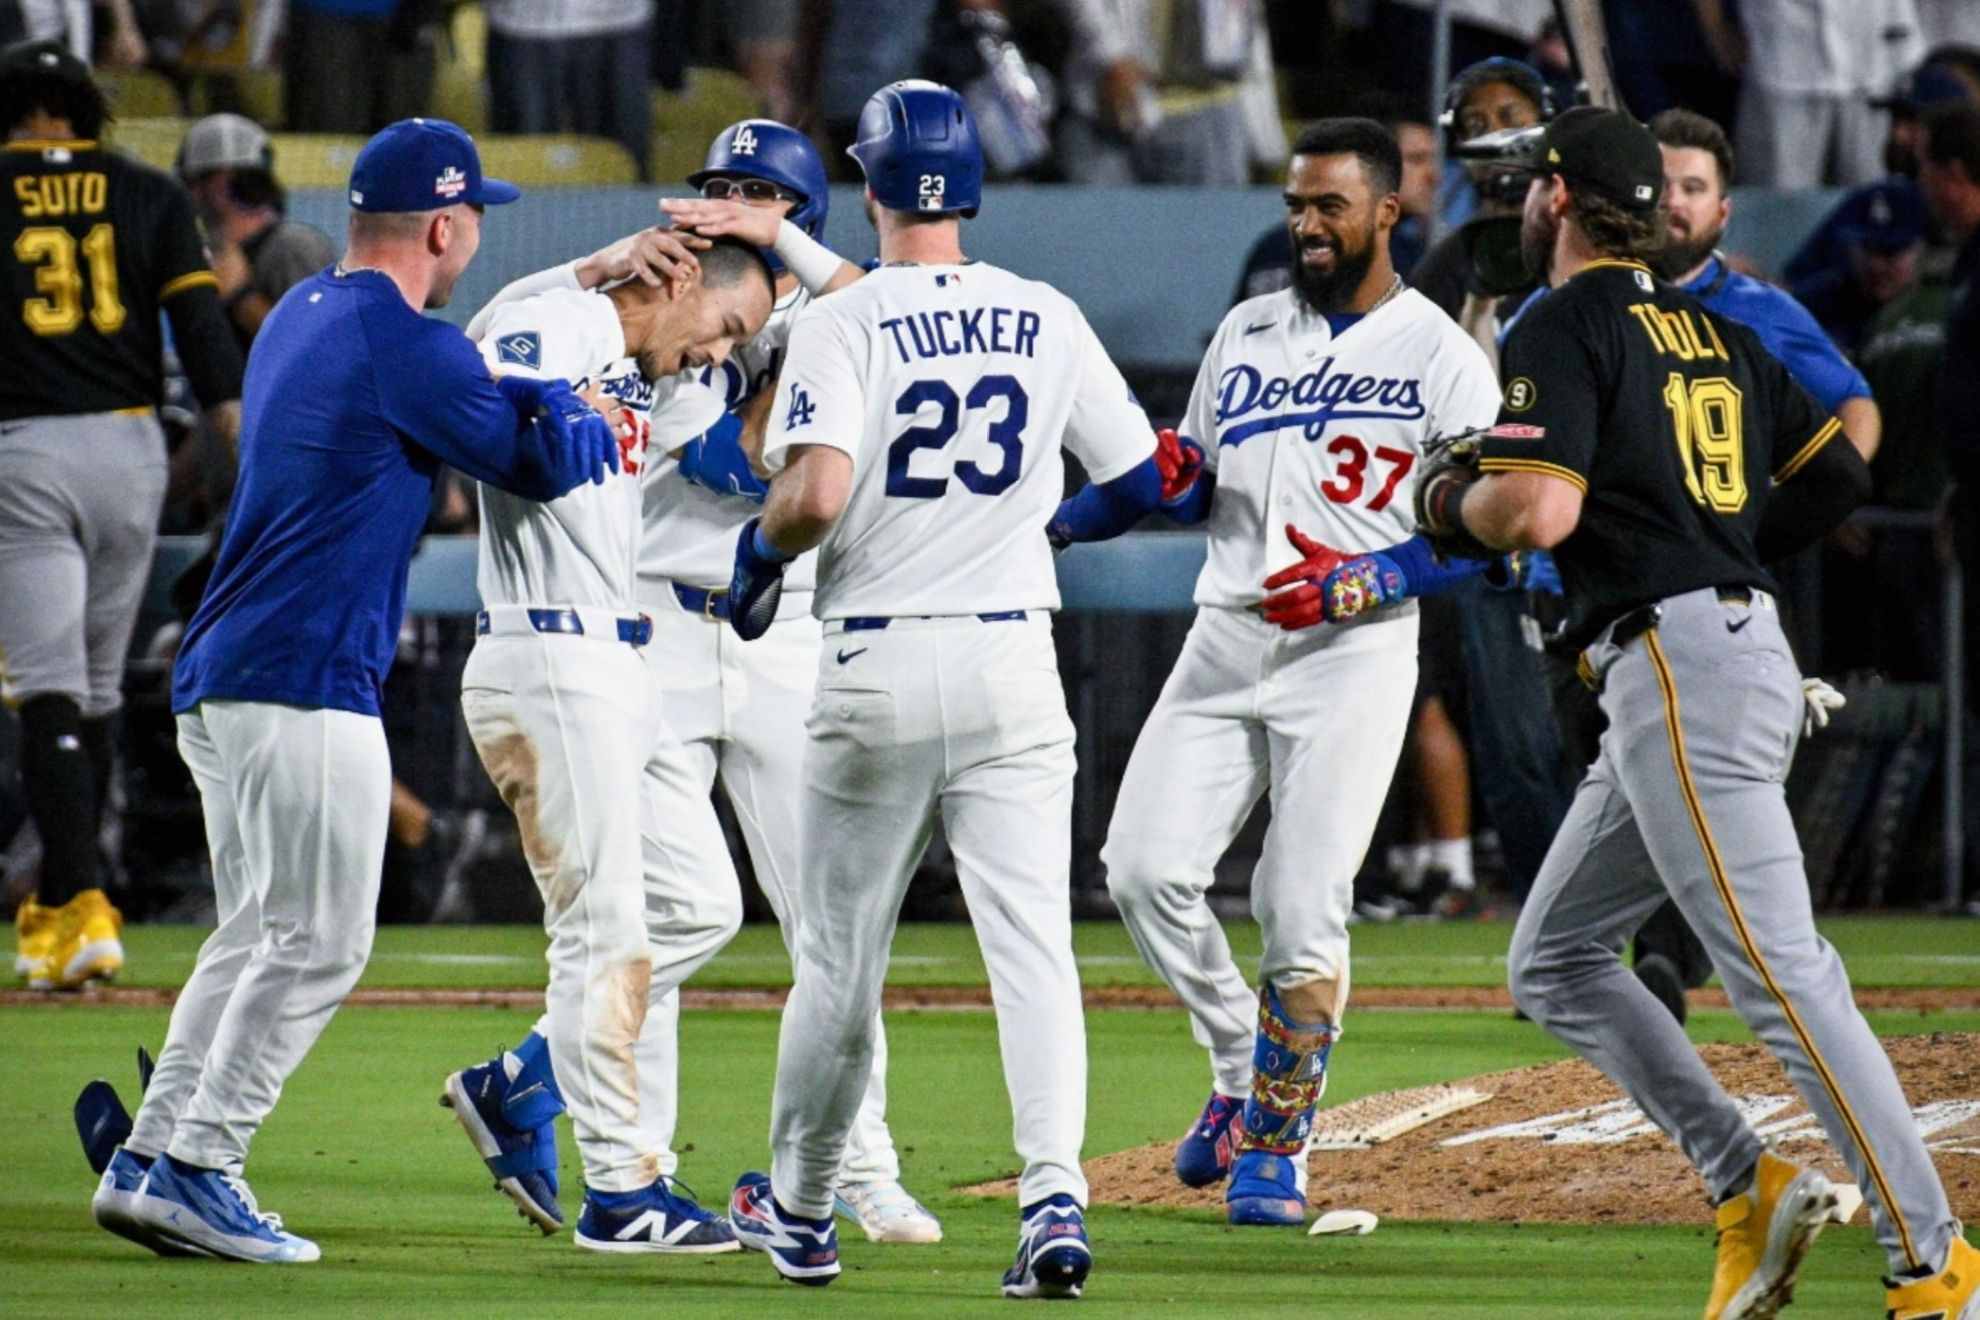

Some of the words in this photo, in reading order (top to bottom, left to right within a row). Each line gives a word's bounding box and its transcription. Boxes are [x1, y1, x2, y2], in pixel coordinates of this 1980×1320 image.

[732, 123, 757, 154] LA
[14, 172, 108, 217] SOTO
[919, 174, 945, 195] 23
[14, 222, 127, 336] 31
[880, 307, 1040, 363] TUCKER
[786, 382, 816, 431] LA
[1216, 357, 1425, 445] Dodgers
[1510, 383, 1527, 407] 9
[886, 374, 1028, 498] 23
[1663, 371, 1748, 512] 19
[1321, 434, 1415, 512] 37
